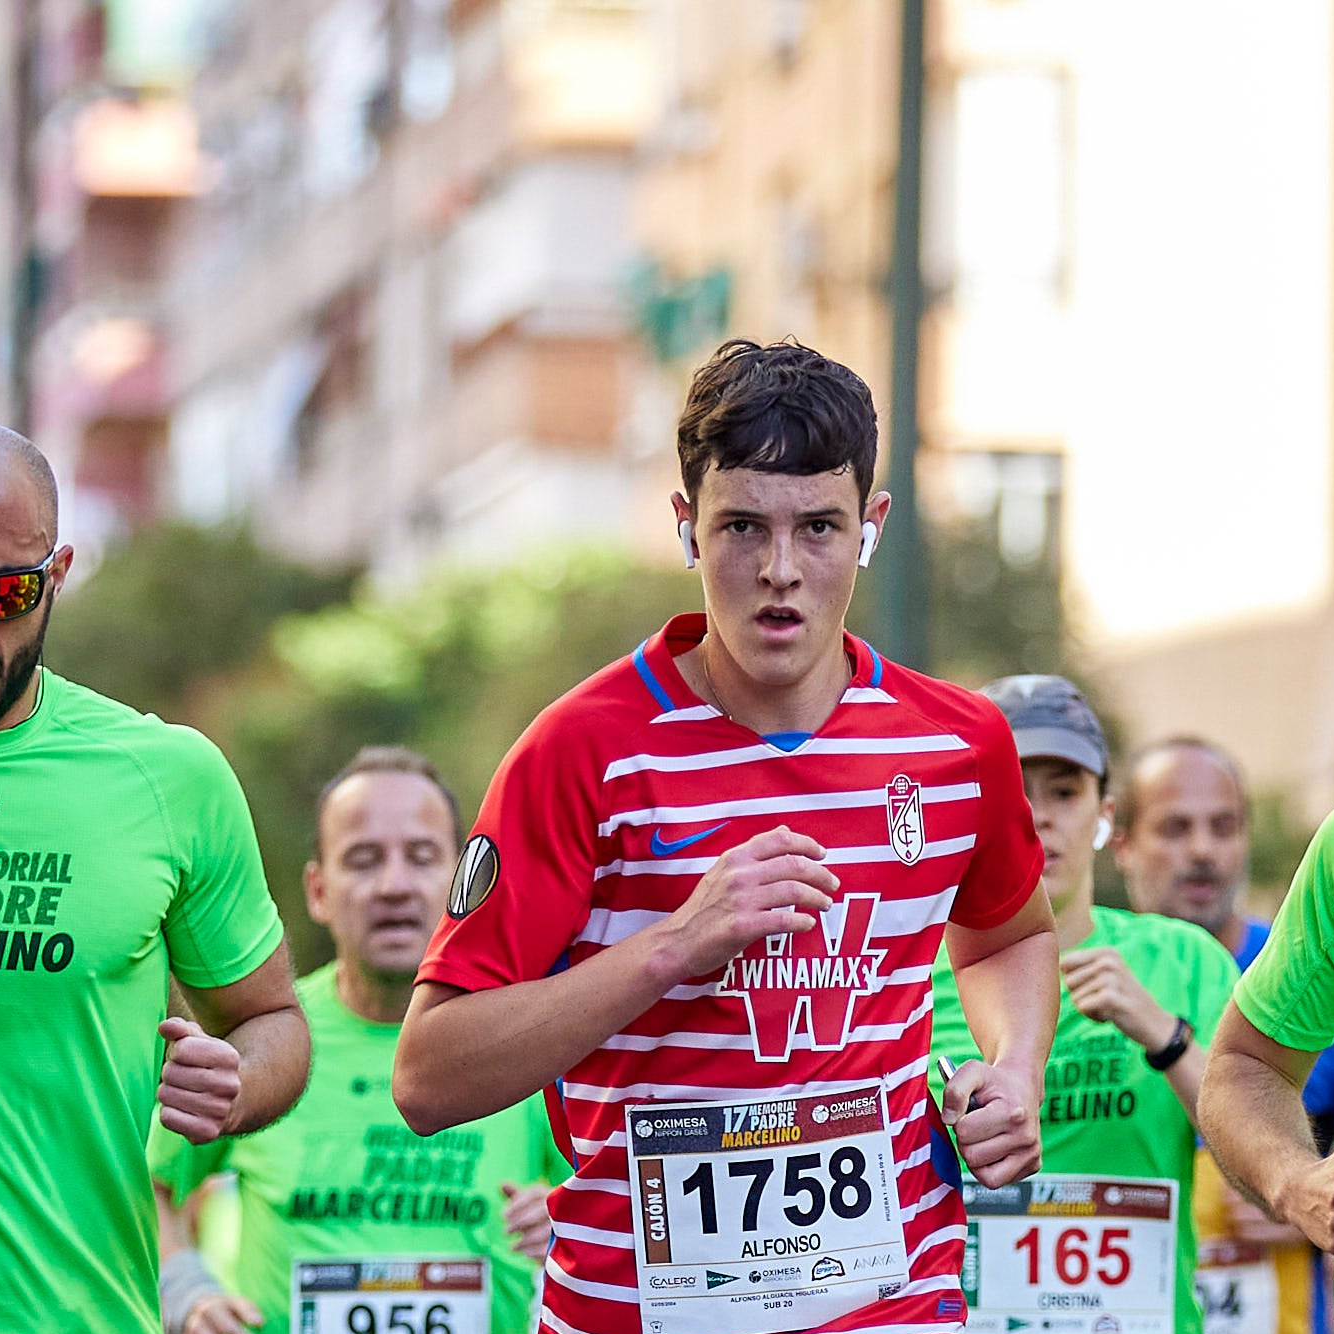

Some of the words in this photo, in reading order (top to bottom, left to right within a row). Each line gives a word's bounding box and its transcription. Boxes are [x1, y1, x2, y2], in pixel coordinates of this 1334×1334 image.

[741, 956, 862, 989] WINAMAX
[1045, 1057, 1122, 1091] ADRE
[830, 1096, 877, 1113] OXIMESA
[1048, 1090, 1135, 1123] ELINO
[654, 1117, 708, 1130] OXIMESA
[722, 1106, 748, 1133] 17
[748, 1100, 798, 1117] MEMORIAL
[750, 1111, 795, 1132] PADRE
[830, 1110, 854, 1122] NIPPON
[655, 1129, 682, 1138] NIPPON
[721, 1125, 801, 1149] MARCELINO
[646, 1177, 662, 1189] 4
[682, 1145, 872, 1235] 1758
[288, 1190, 491, 1224] MARCELINO
[644, 1193, 667, 1242] CAJÓN
[741, 1233, 821, 1259] ALFONSO
[1014, 1225, 1132, 1287] 165
[762, 1267, 802, 1277] OXIMESA
[854, 1254, 896, 1270] ANAYA
[653, 1276, 696, 1287] CALERO
[730, 1295, 762, 1303] ALFONSO
[762, 1291, 795, 1300] ALGUACIL
[763, 1302, 782, 1310] SUB
